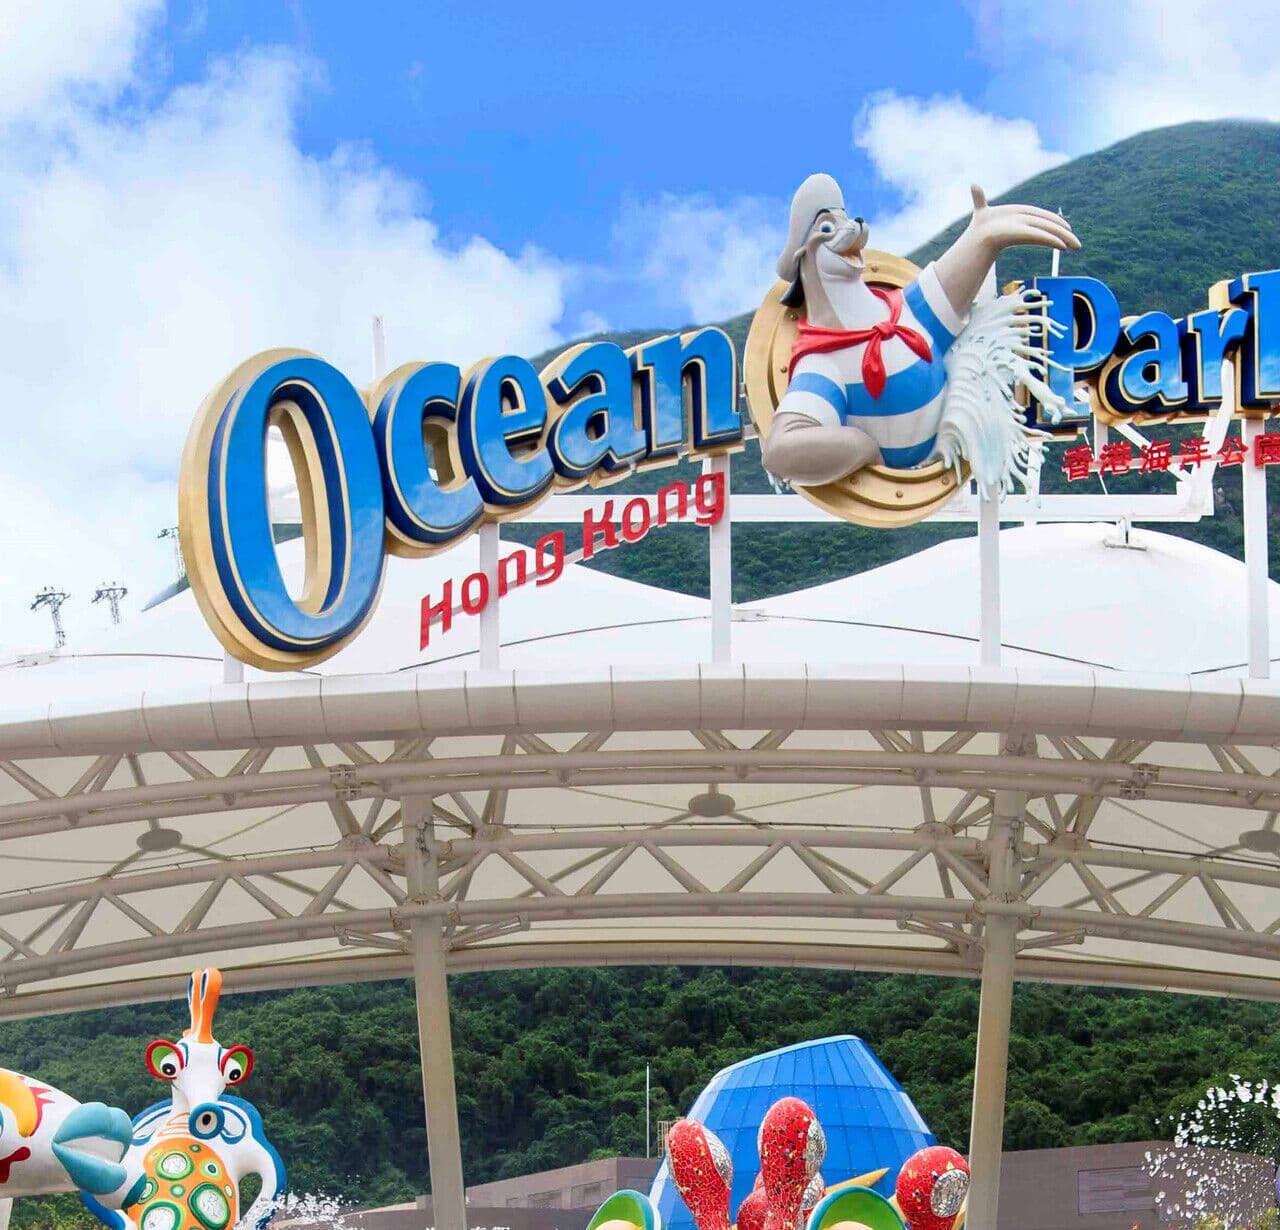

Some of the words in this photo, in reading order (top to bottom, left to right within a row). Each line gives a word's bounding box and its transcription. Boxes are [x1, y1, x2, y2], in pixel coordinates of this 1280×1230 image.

[190, 325, 743, 664] Ocean
[419, 529, 565, 652] Hong
[581, 471, 726, 560] Kong
